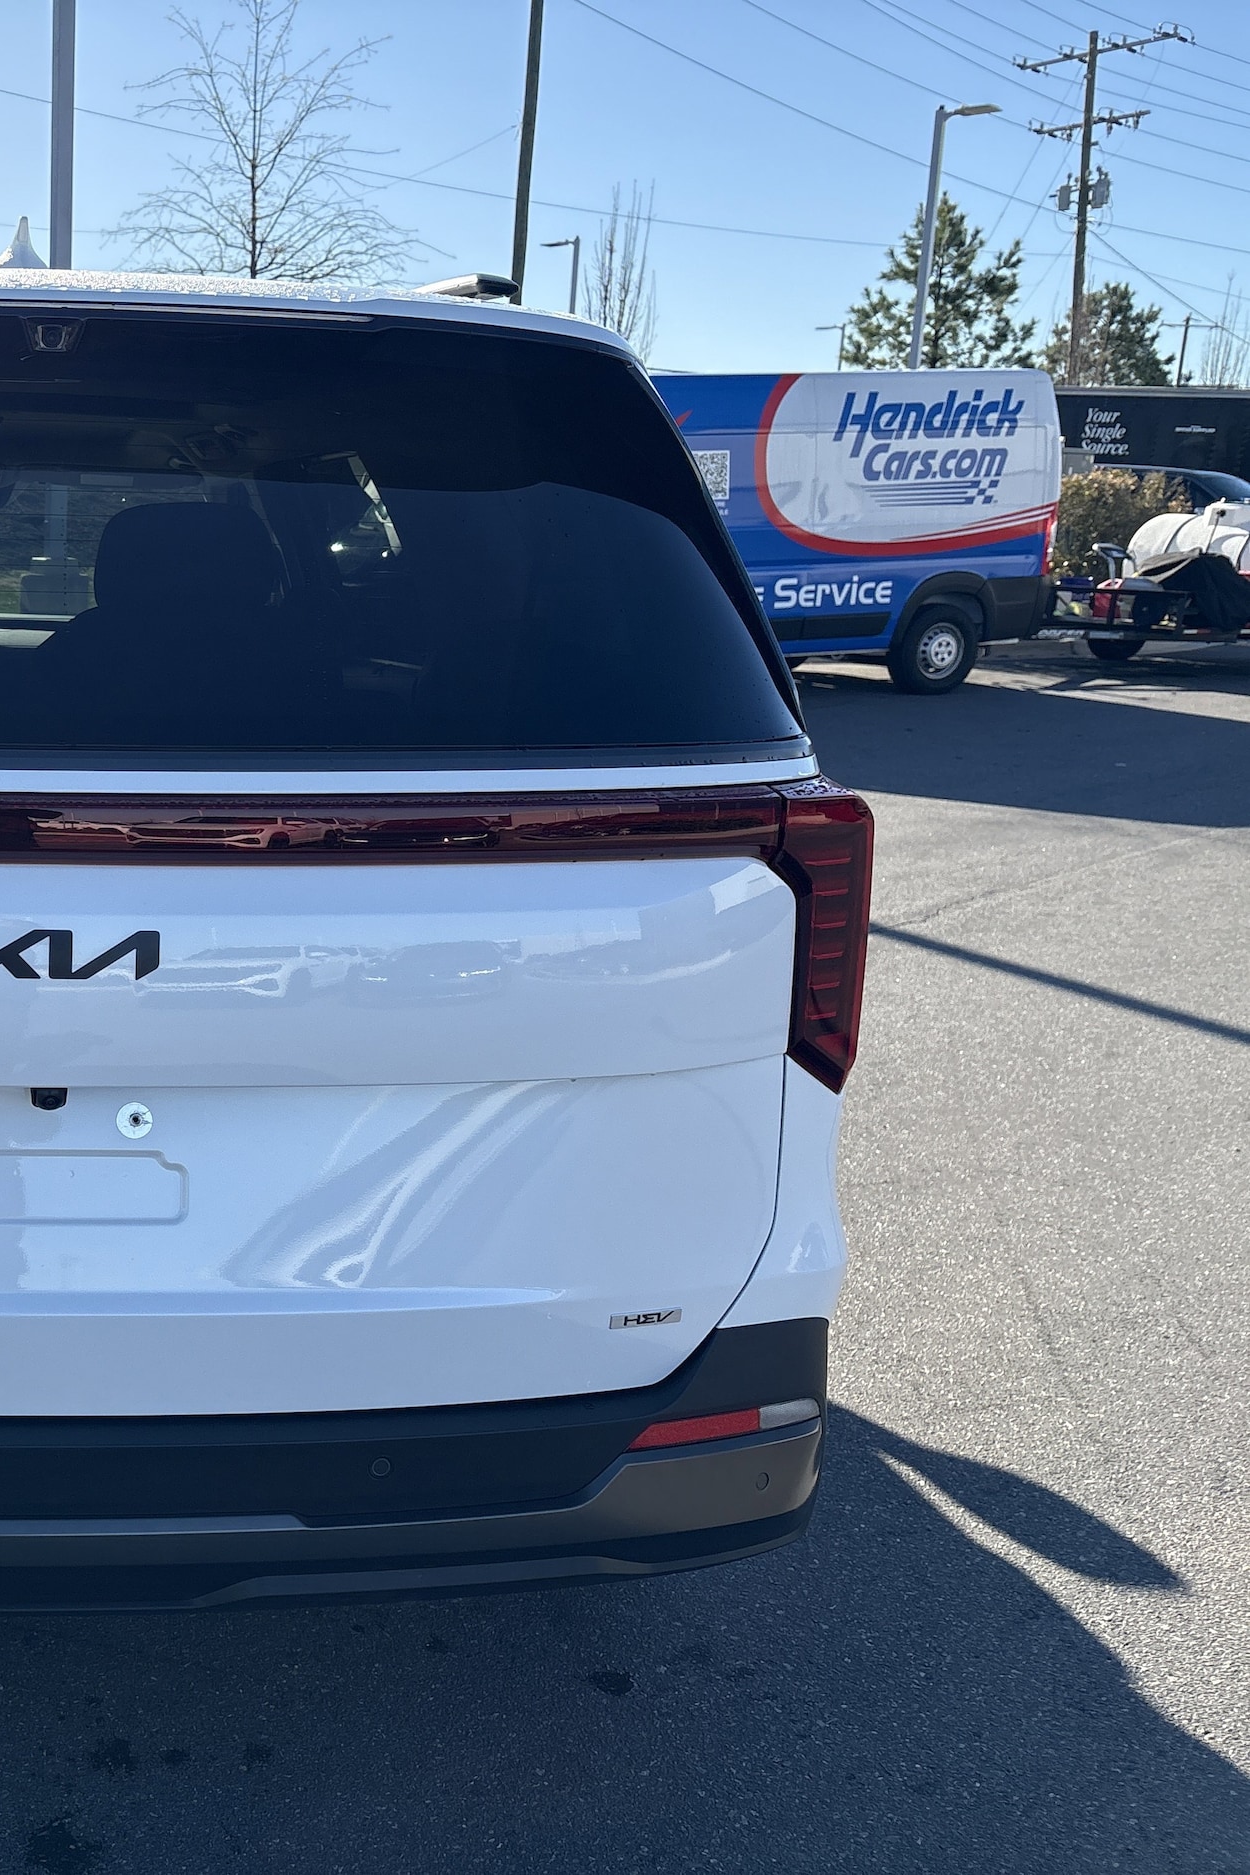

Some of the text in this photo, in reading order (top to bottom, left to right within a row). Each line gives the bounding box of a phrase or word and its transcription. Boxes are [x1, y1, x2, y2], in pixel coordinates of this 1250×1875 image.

[833, 388, 1025, 458] Hendrick
[1085, 407, 1121, 424] Your
[1081, 423, 1127, 443] Single
[1081, 440, 1130, 456] Source.
[863, 443, 1008, 481] Cars.com
[773, 575, 893, 609] Service
[623, 1310, 675, 1327] HEV
